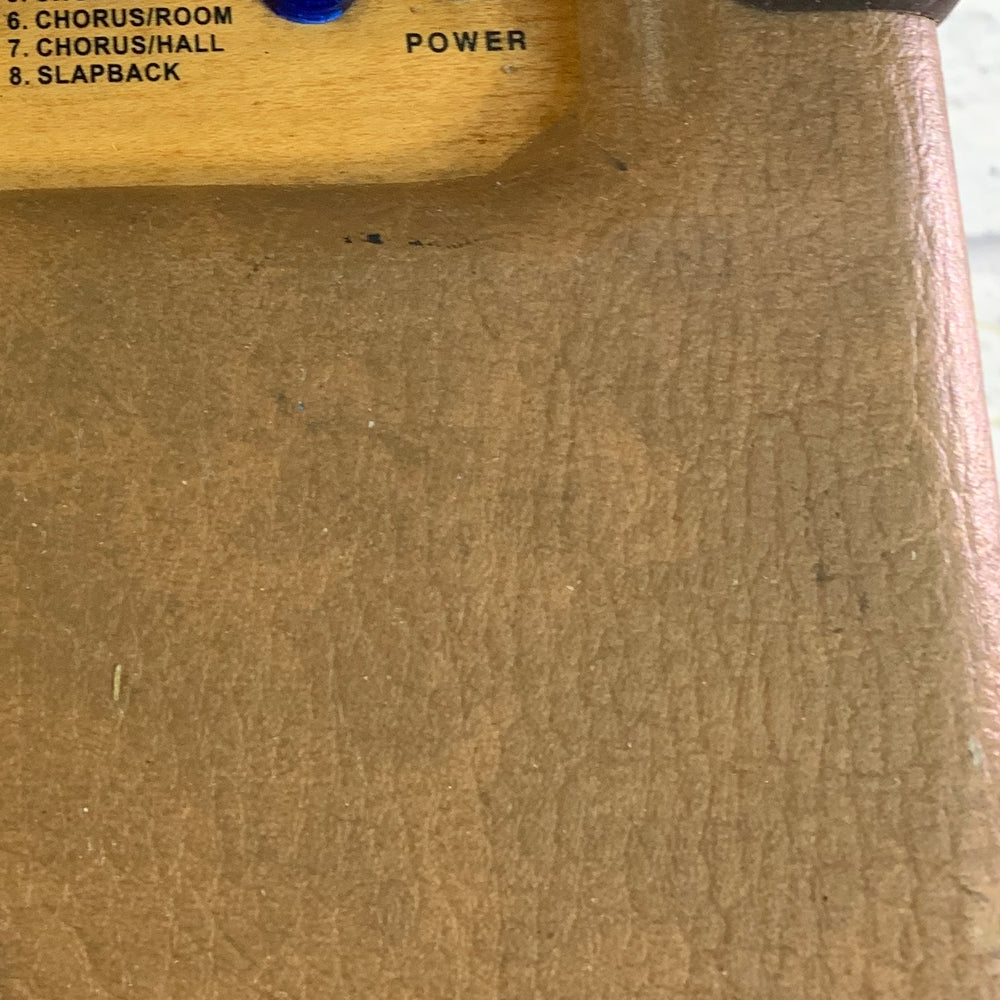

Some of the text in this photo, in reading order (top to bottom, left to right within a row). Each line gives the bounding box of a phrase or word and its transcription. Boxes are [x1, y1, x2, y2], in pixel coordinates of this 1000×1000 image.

[7, 6, 233, 30] 6. CHORUS/ROOM
[8, 33, 225, 57] 7. CHORUS/HALL
[407, 32, 527, 53] POWER
[9, 63, 181, 86] 8. SLAPBACK
